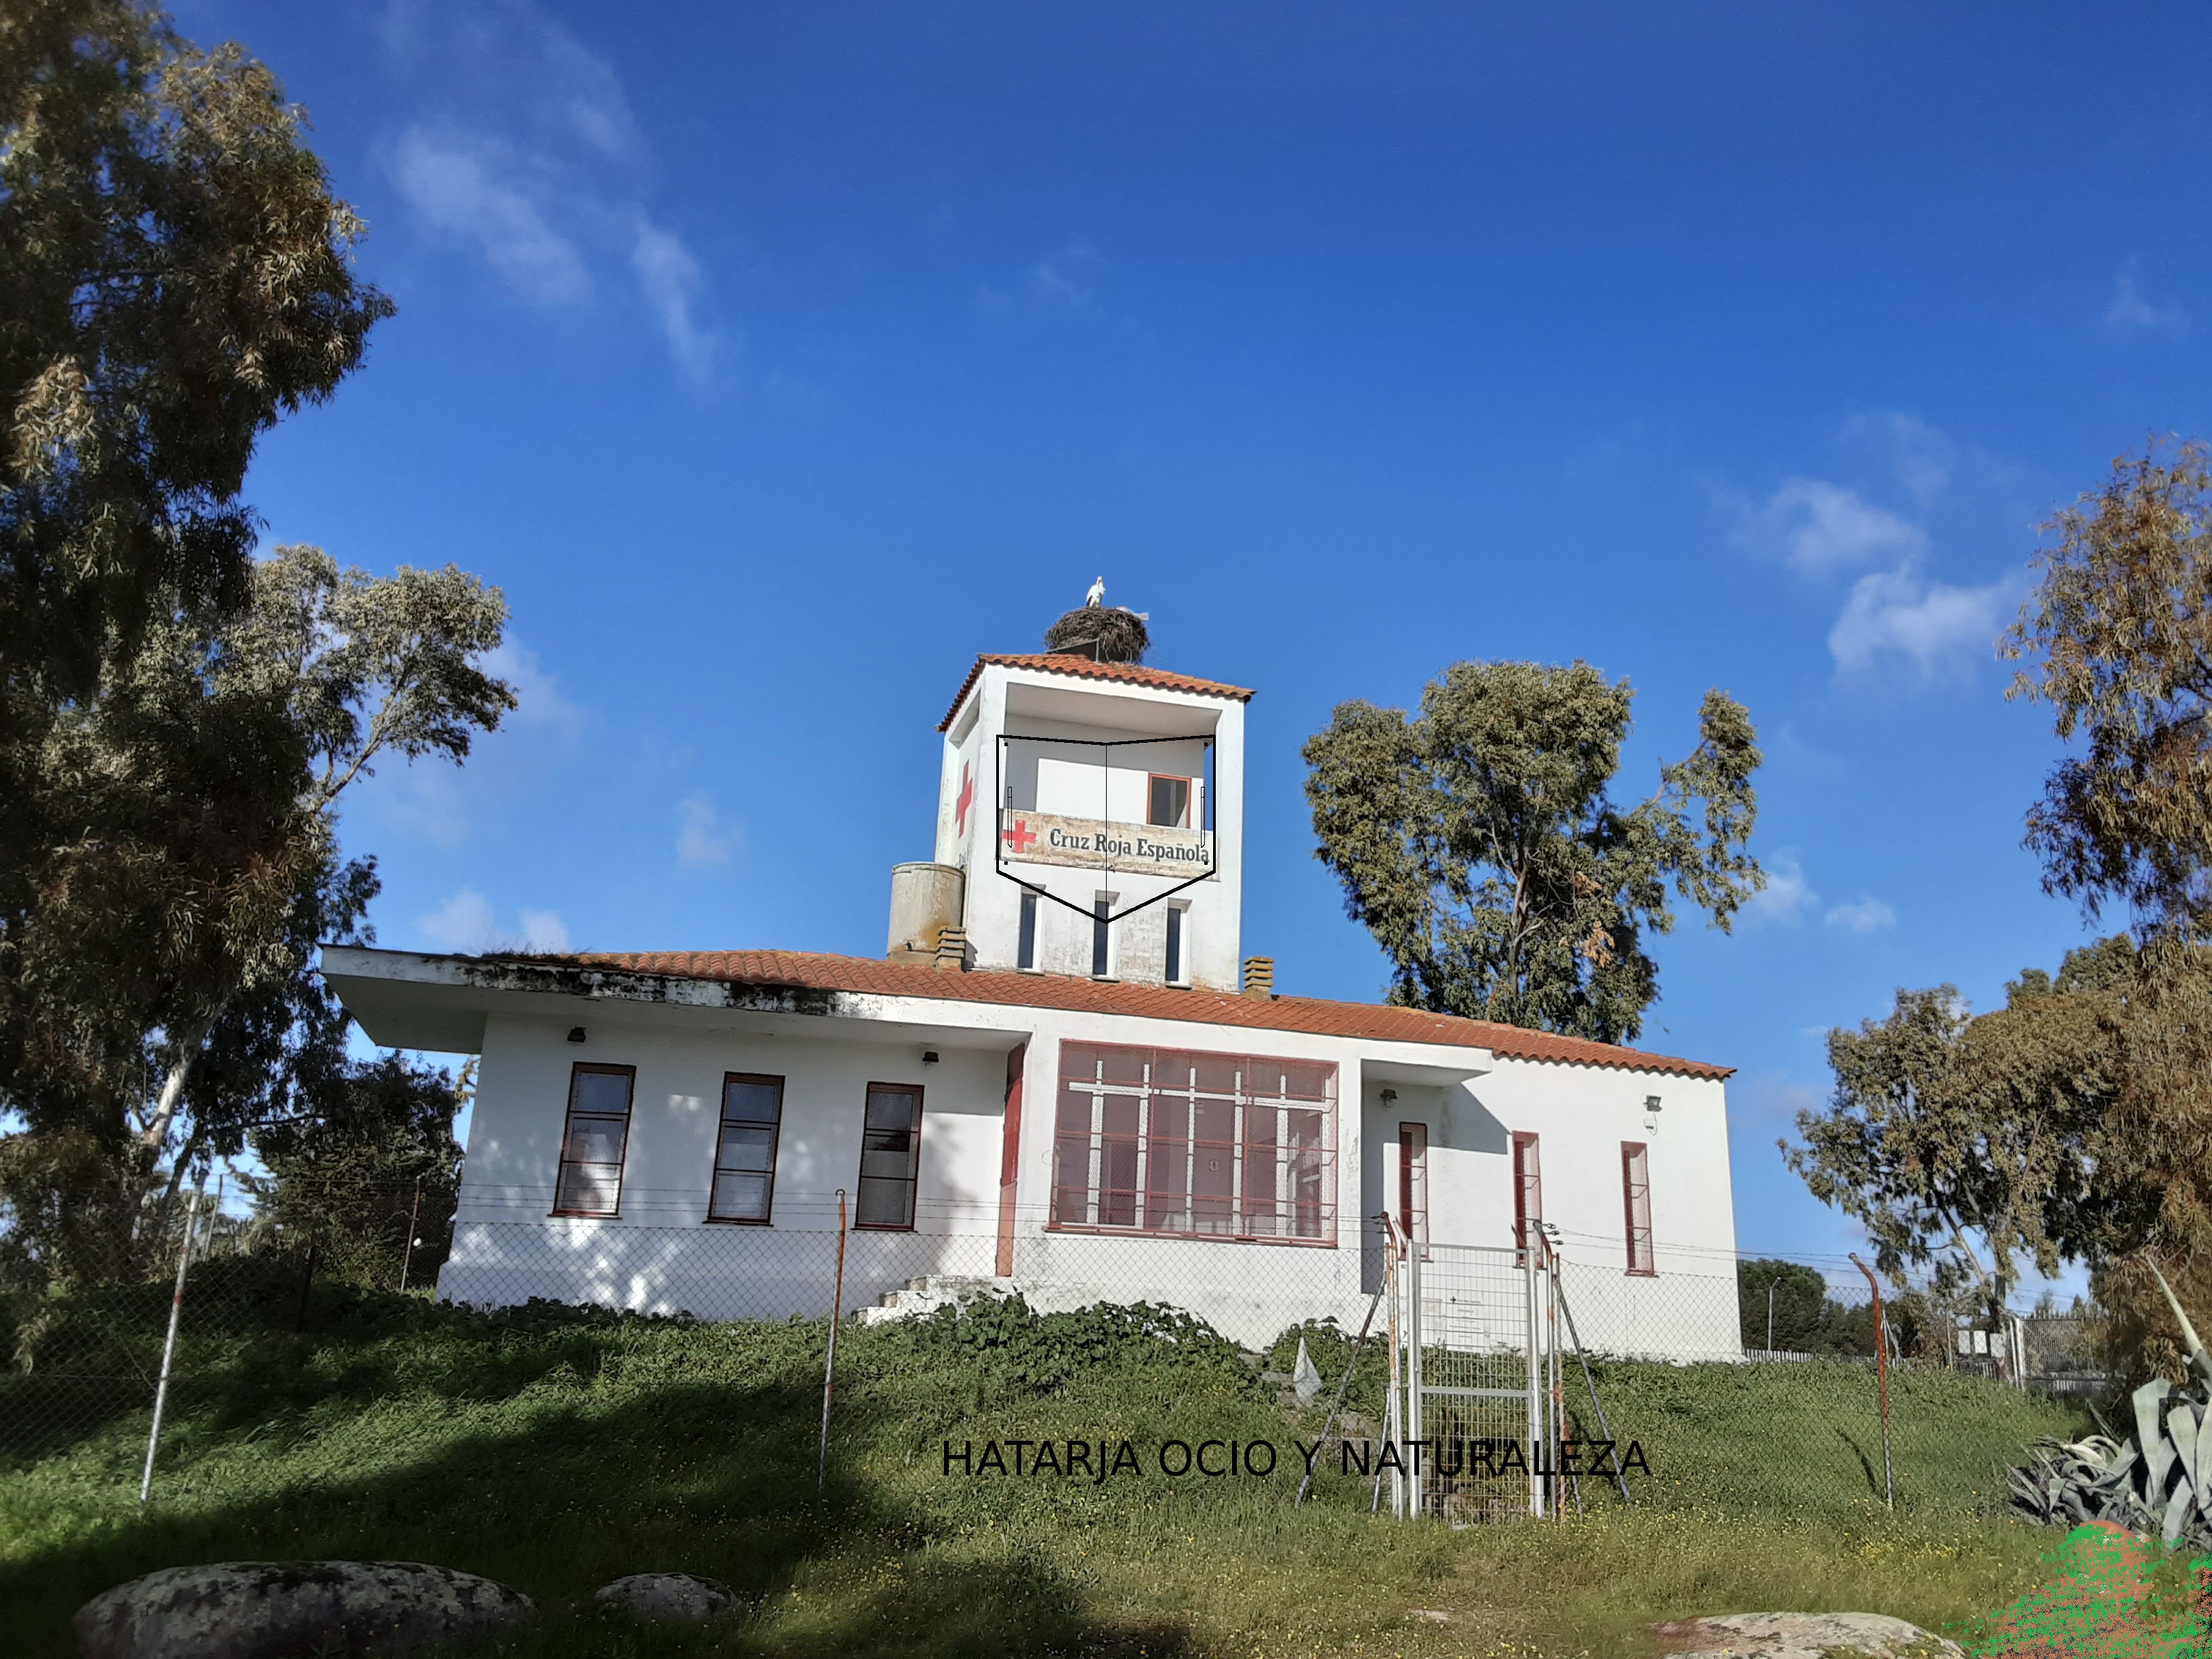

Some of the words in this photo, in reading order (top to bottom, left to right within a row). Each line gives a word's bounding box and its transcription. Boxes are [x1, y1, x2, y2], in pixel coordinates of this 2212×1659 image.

[1050, 828, 1090, 850] Cruz
[1094, 833, 1132, 856] Roja
[1136, 838, 1210, 862] Española
